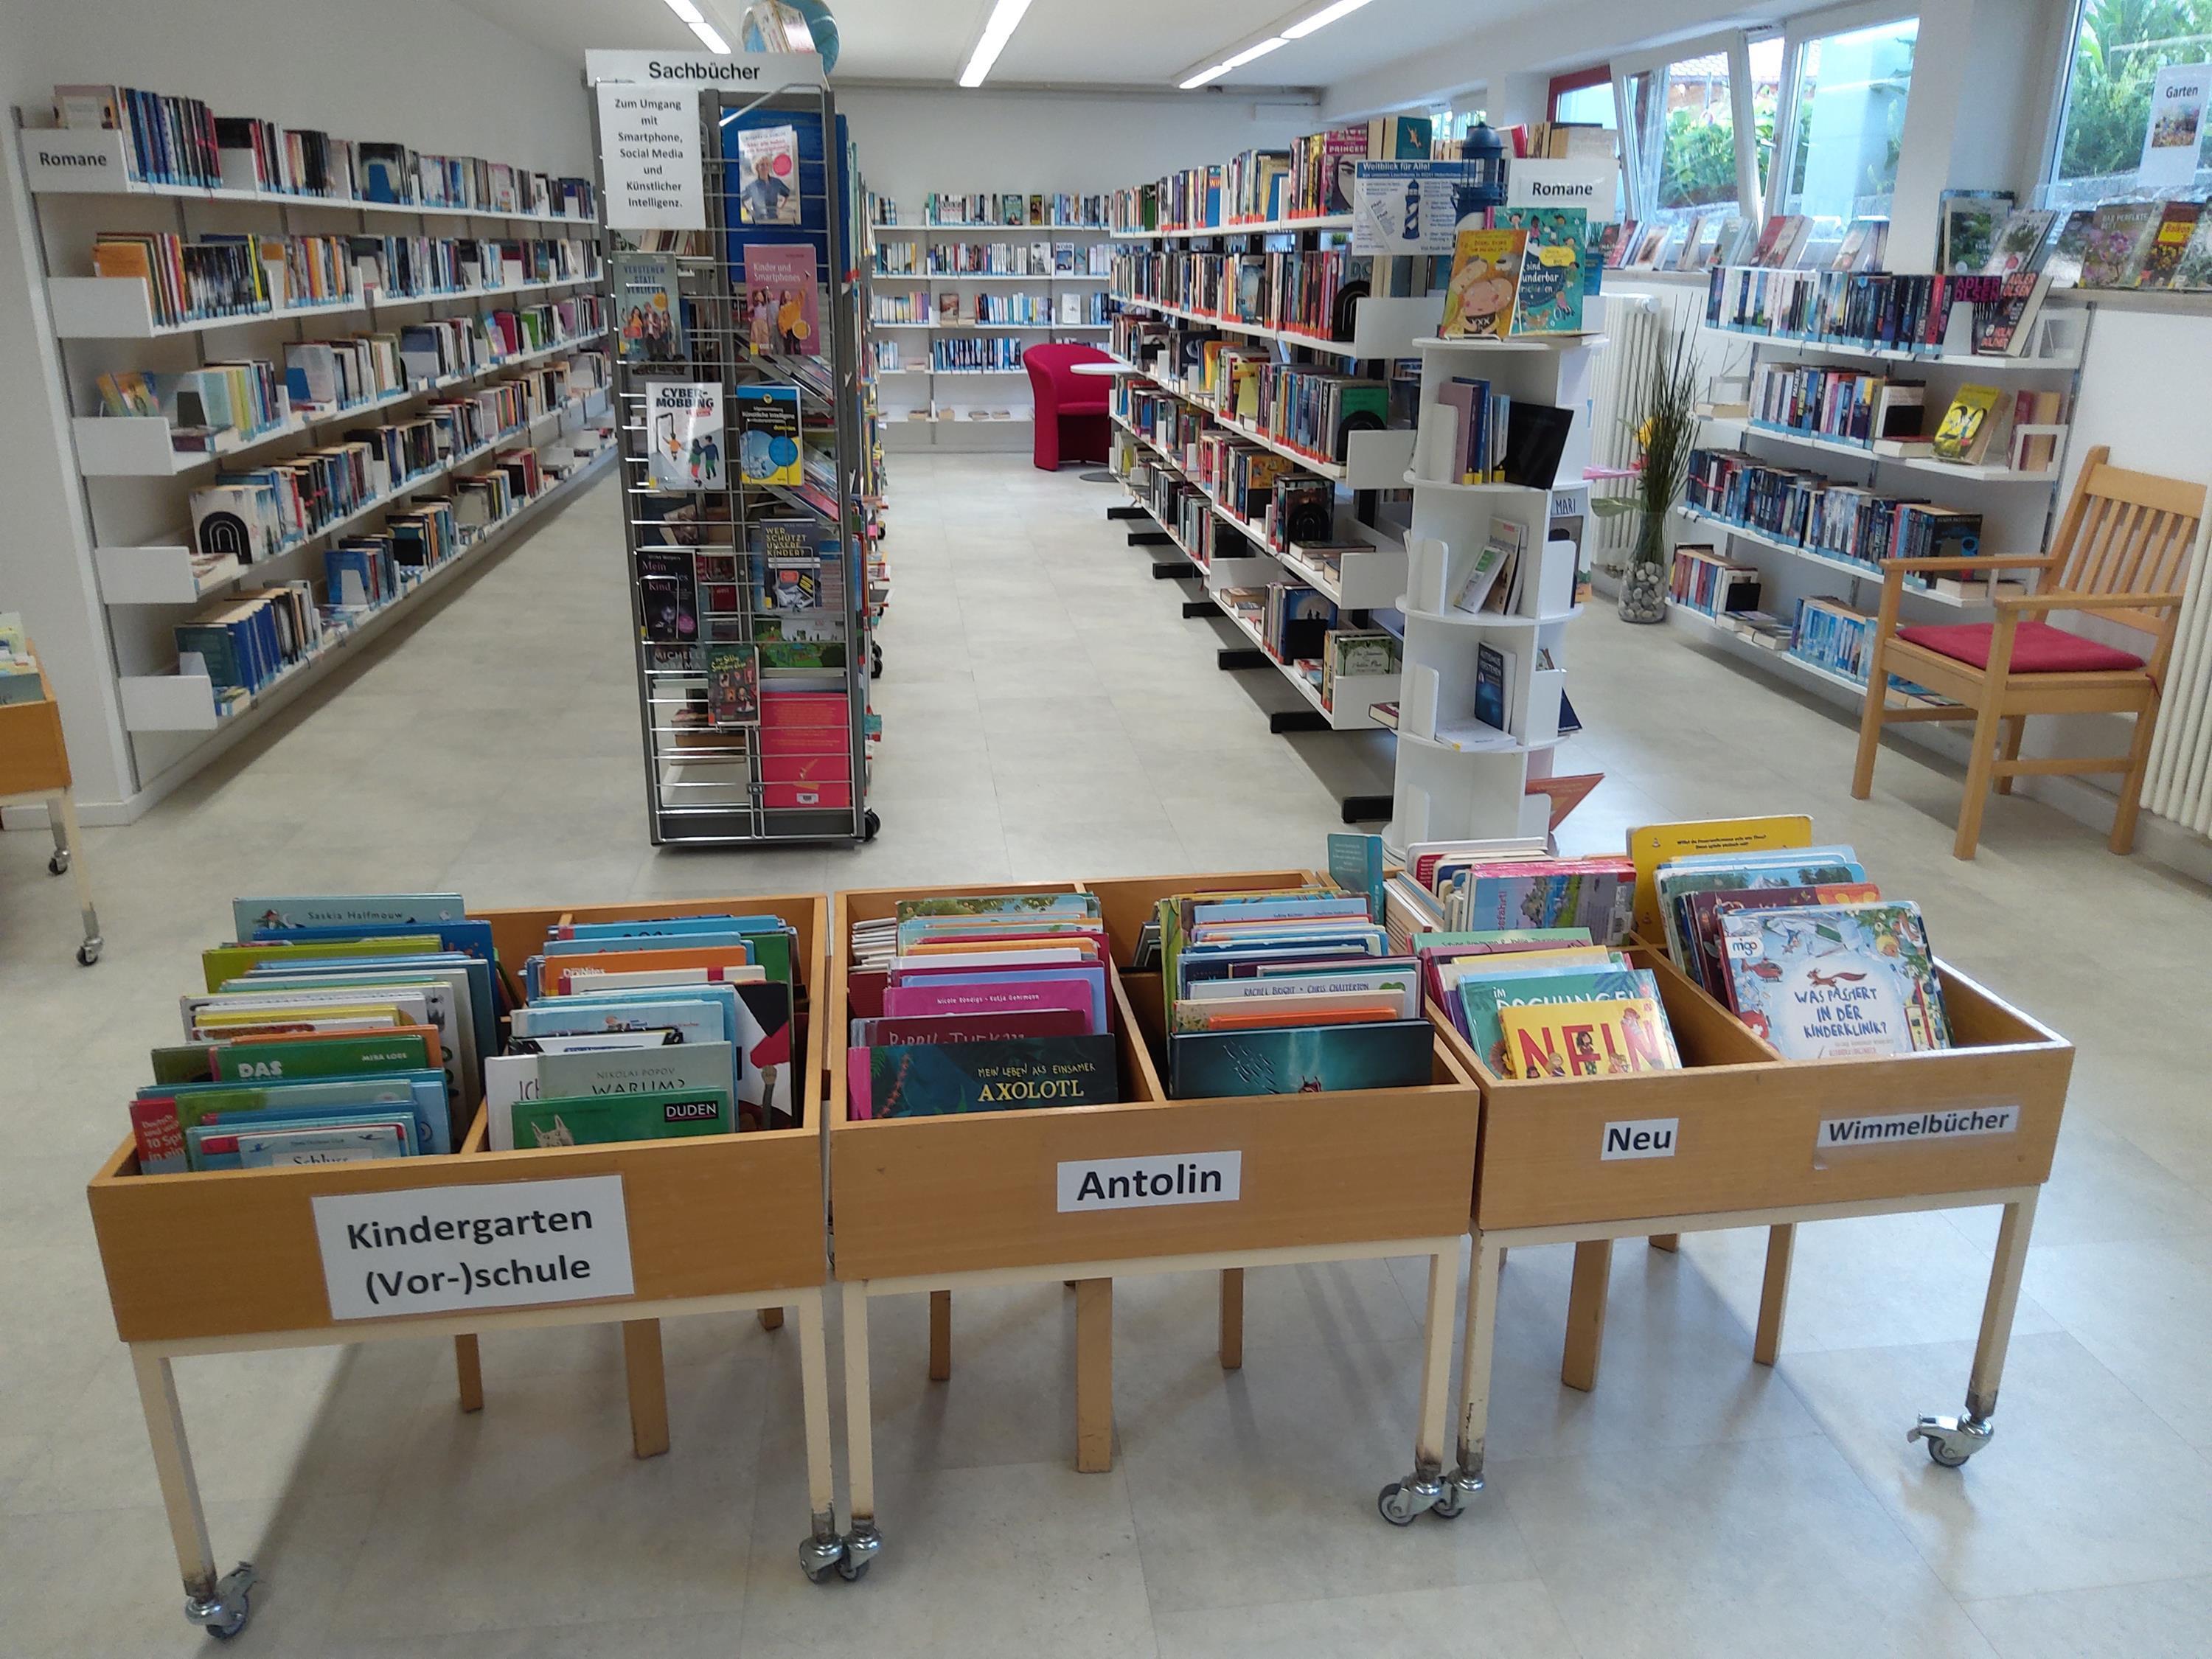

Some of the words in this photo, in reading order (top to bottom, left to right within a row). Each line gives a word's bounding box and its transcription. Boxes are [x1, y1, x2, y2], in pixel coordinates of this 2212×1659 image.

[649, 61, 760, 80] Sachbücher
[2166, 86, 2199, 99] Garten
[615, 99, 637, 109] Zum
[641, 99, 681, 111] Umgang
[641, 116, 658, 125] mit
[618, 132, 683, 144] Smartphone,
[39, 152, 107, 167] Romane
[620, 149, 648, 159] Social
[652, 149, 683, 159] Media
[644, 165, 663, 175] und
[1400, 162, 1411, 170] für
[627, 181, 681, 192] Künstlicher
[1532, 182, 1593, 197] Romane
[629, 198, 682, 208] Intelligenz.
[754, 263, 776, 271] Kinder
[778, 263, 790, 271] und
[1526, 262, 1540, 271] sind
[754, 273, 801, 282] Smartphones
[1522, 274, 1559, 282] underbar
[1956, 277, 2000, 289] ADLER
[1955, 290, 2000, 302] OLSEN
[662, 388, 708, 398] CYBER-
[308, 911, 342, 919] Saskia
[348, 911, 402, 919] Halfmouw
[1733, 938, 1758, 956] migo
[1244, 987, 1268, 997] RACHEL
[1273, 986, 1295, 995] BRIGHT
[1307, 984, 1326, 994] CHRIS
[1329, 983, 1369, 992] CHATTERTON
[1795, 990, 1824, 1004] WAS
[1817, 1006, 1832, 1023] IN
[1837, 1004, 1863, 1021] DER
[1804, 1021, 1888, 1038] KINDERKLINIK?
[1517, 1020, 1665, 1076] NEIN
[237, 1061, 282, 1078] DAS
[597, 1069, 638, 1079] NIKOLAI
[642, 1068, 675, 1077] POPOV
[978, 1067, 998, 1078] MEIN
[1003, 1063, 1027, 1078] LEBEN
[1032, 1065, 1047, 1076] ALS
[1053, 1062, 1096, 1074] EINSAMER
[978, 1080, 1085, 1102] AXOLOTL
[666, 1103, 717, 1118] DUDEN
[1829, 1110, 2009, 1142] Wimmelbücher
[1607, 1127, 1671, 1152] Neu
[1077, 1164, 1221, 1201] Antolin
[347, 1208, 593, 1250] Kindergarten
[366, 1255, 591, 1304] (Vor-)schule
